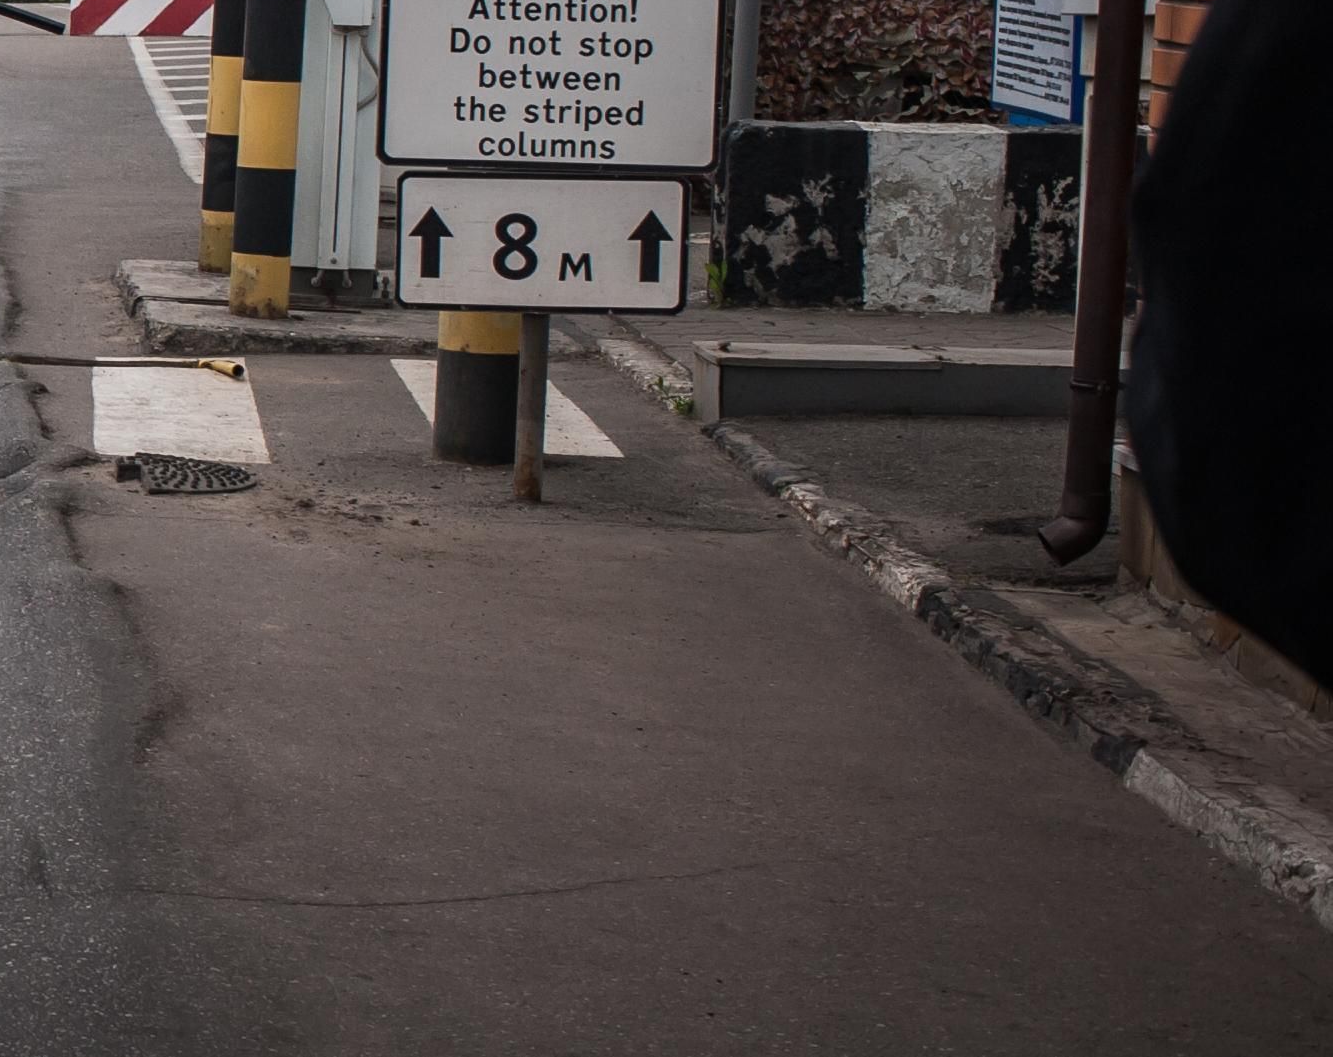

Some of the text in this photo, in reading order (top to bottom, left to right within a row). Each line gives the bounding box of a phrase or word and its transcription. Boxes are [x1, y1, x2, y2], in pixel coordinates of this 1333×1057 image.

[451, 28, 653, 64] Do not stop
[479, 63, 620, 91] between
[454, 96, 643, 131] the striped
[479, 132, 615, 159] columns
[493, 213, 537, 280] 8
